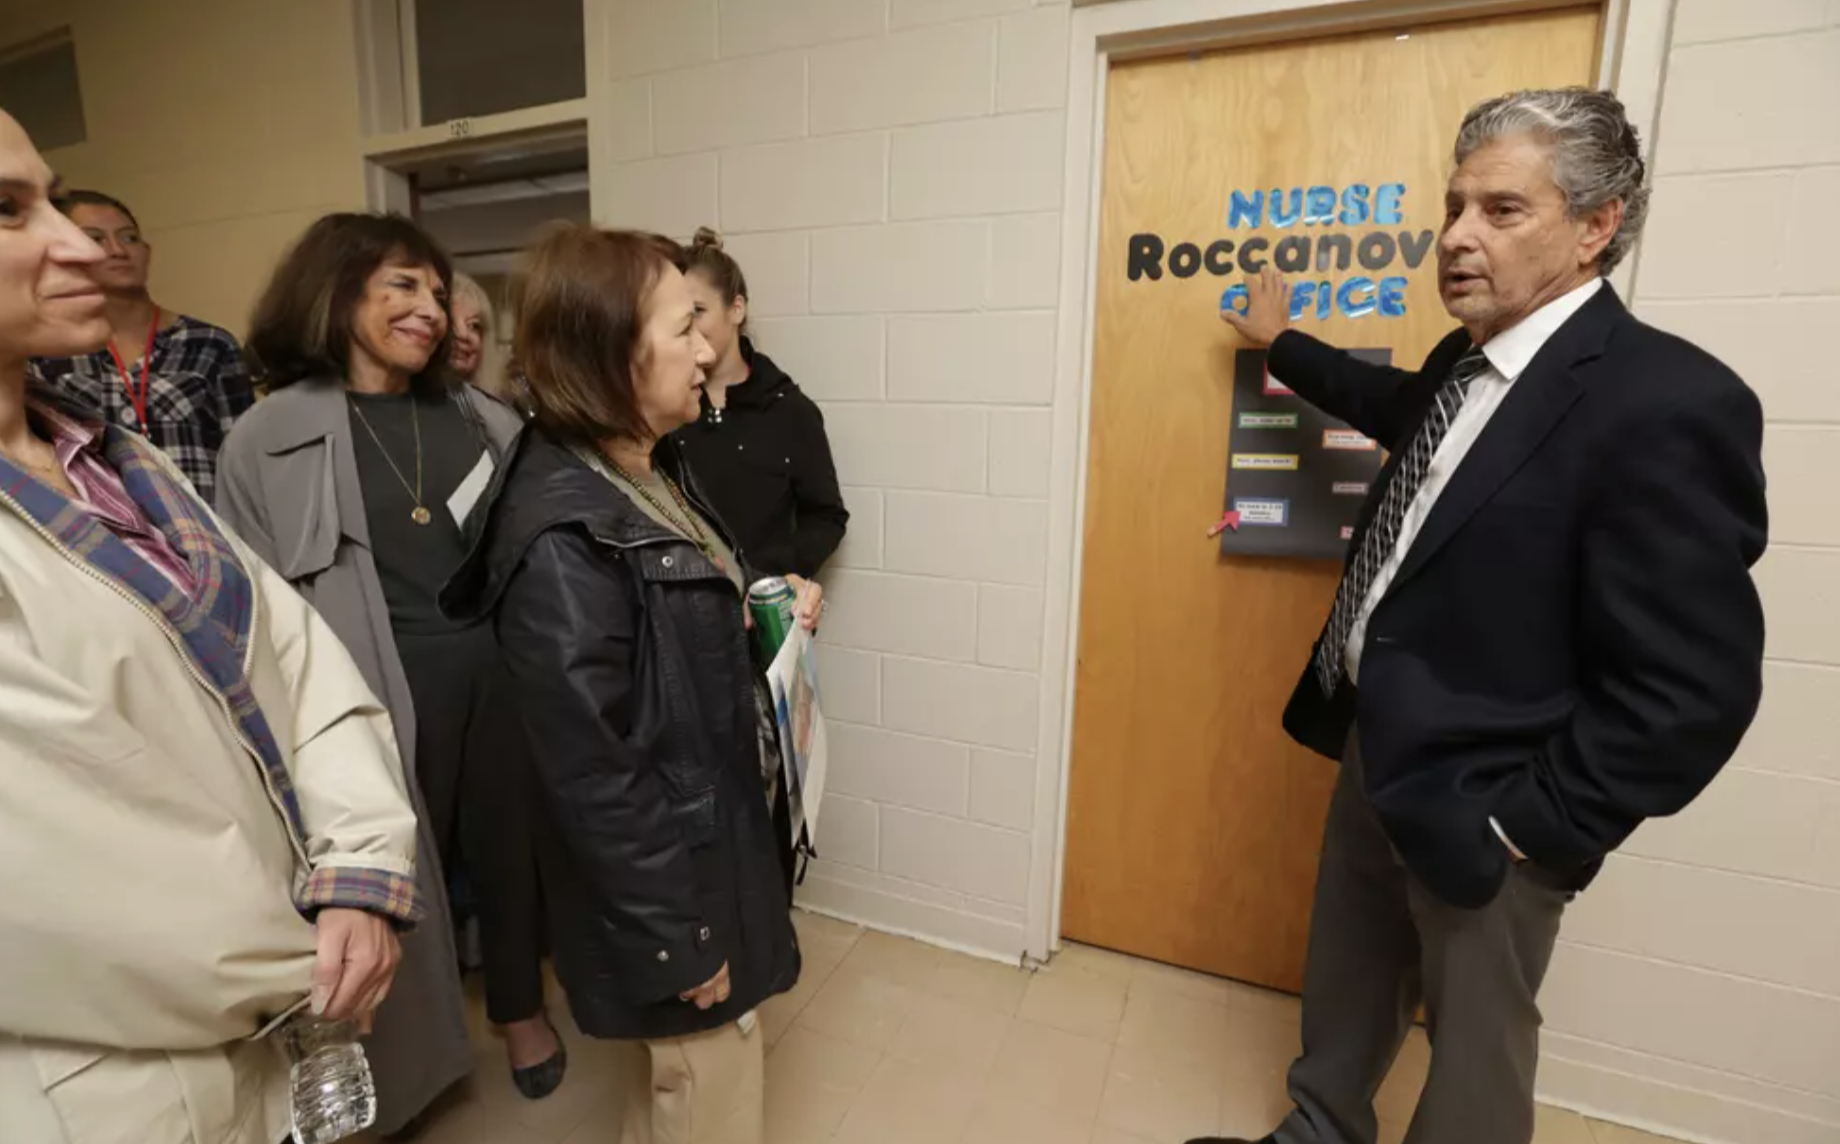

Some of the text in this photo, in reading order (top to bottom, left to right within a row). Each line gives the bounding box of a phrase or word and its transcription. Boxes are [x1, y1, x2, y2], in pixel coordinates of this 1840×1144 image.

[450, 120, 469, 136] 120
[1226, 183, 1406, 229] NURSE
[1220, 276, 1408, 320] OFICE
